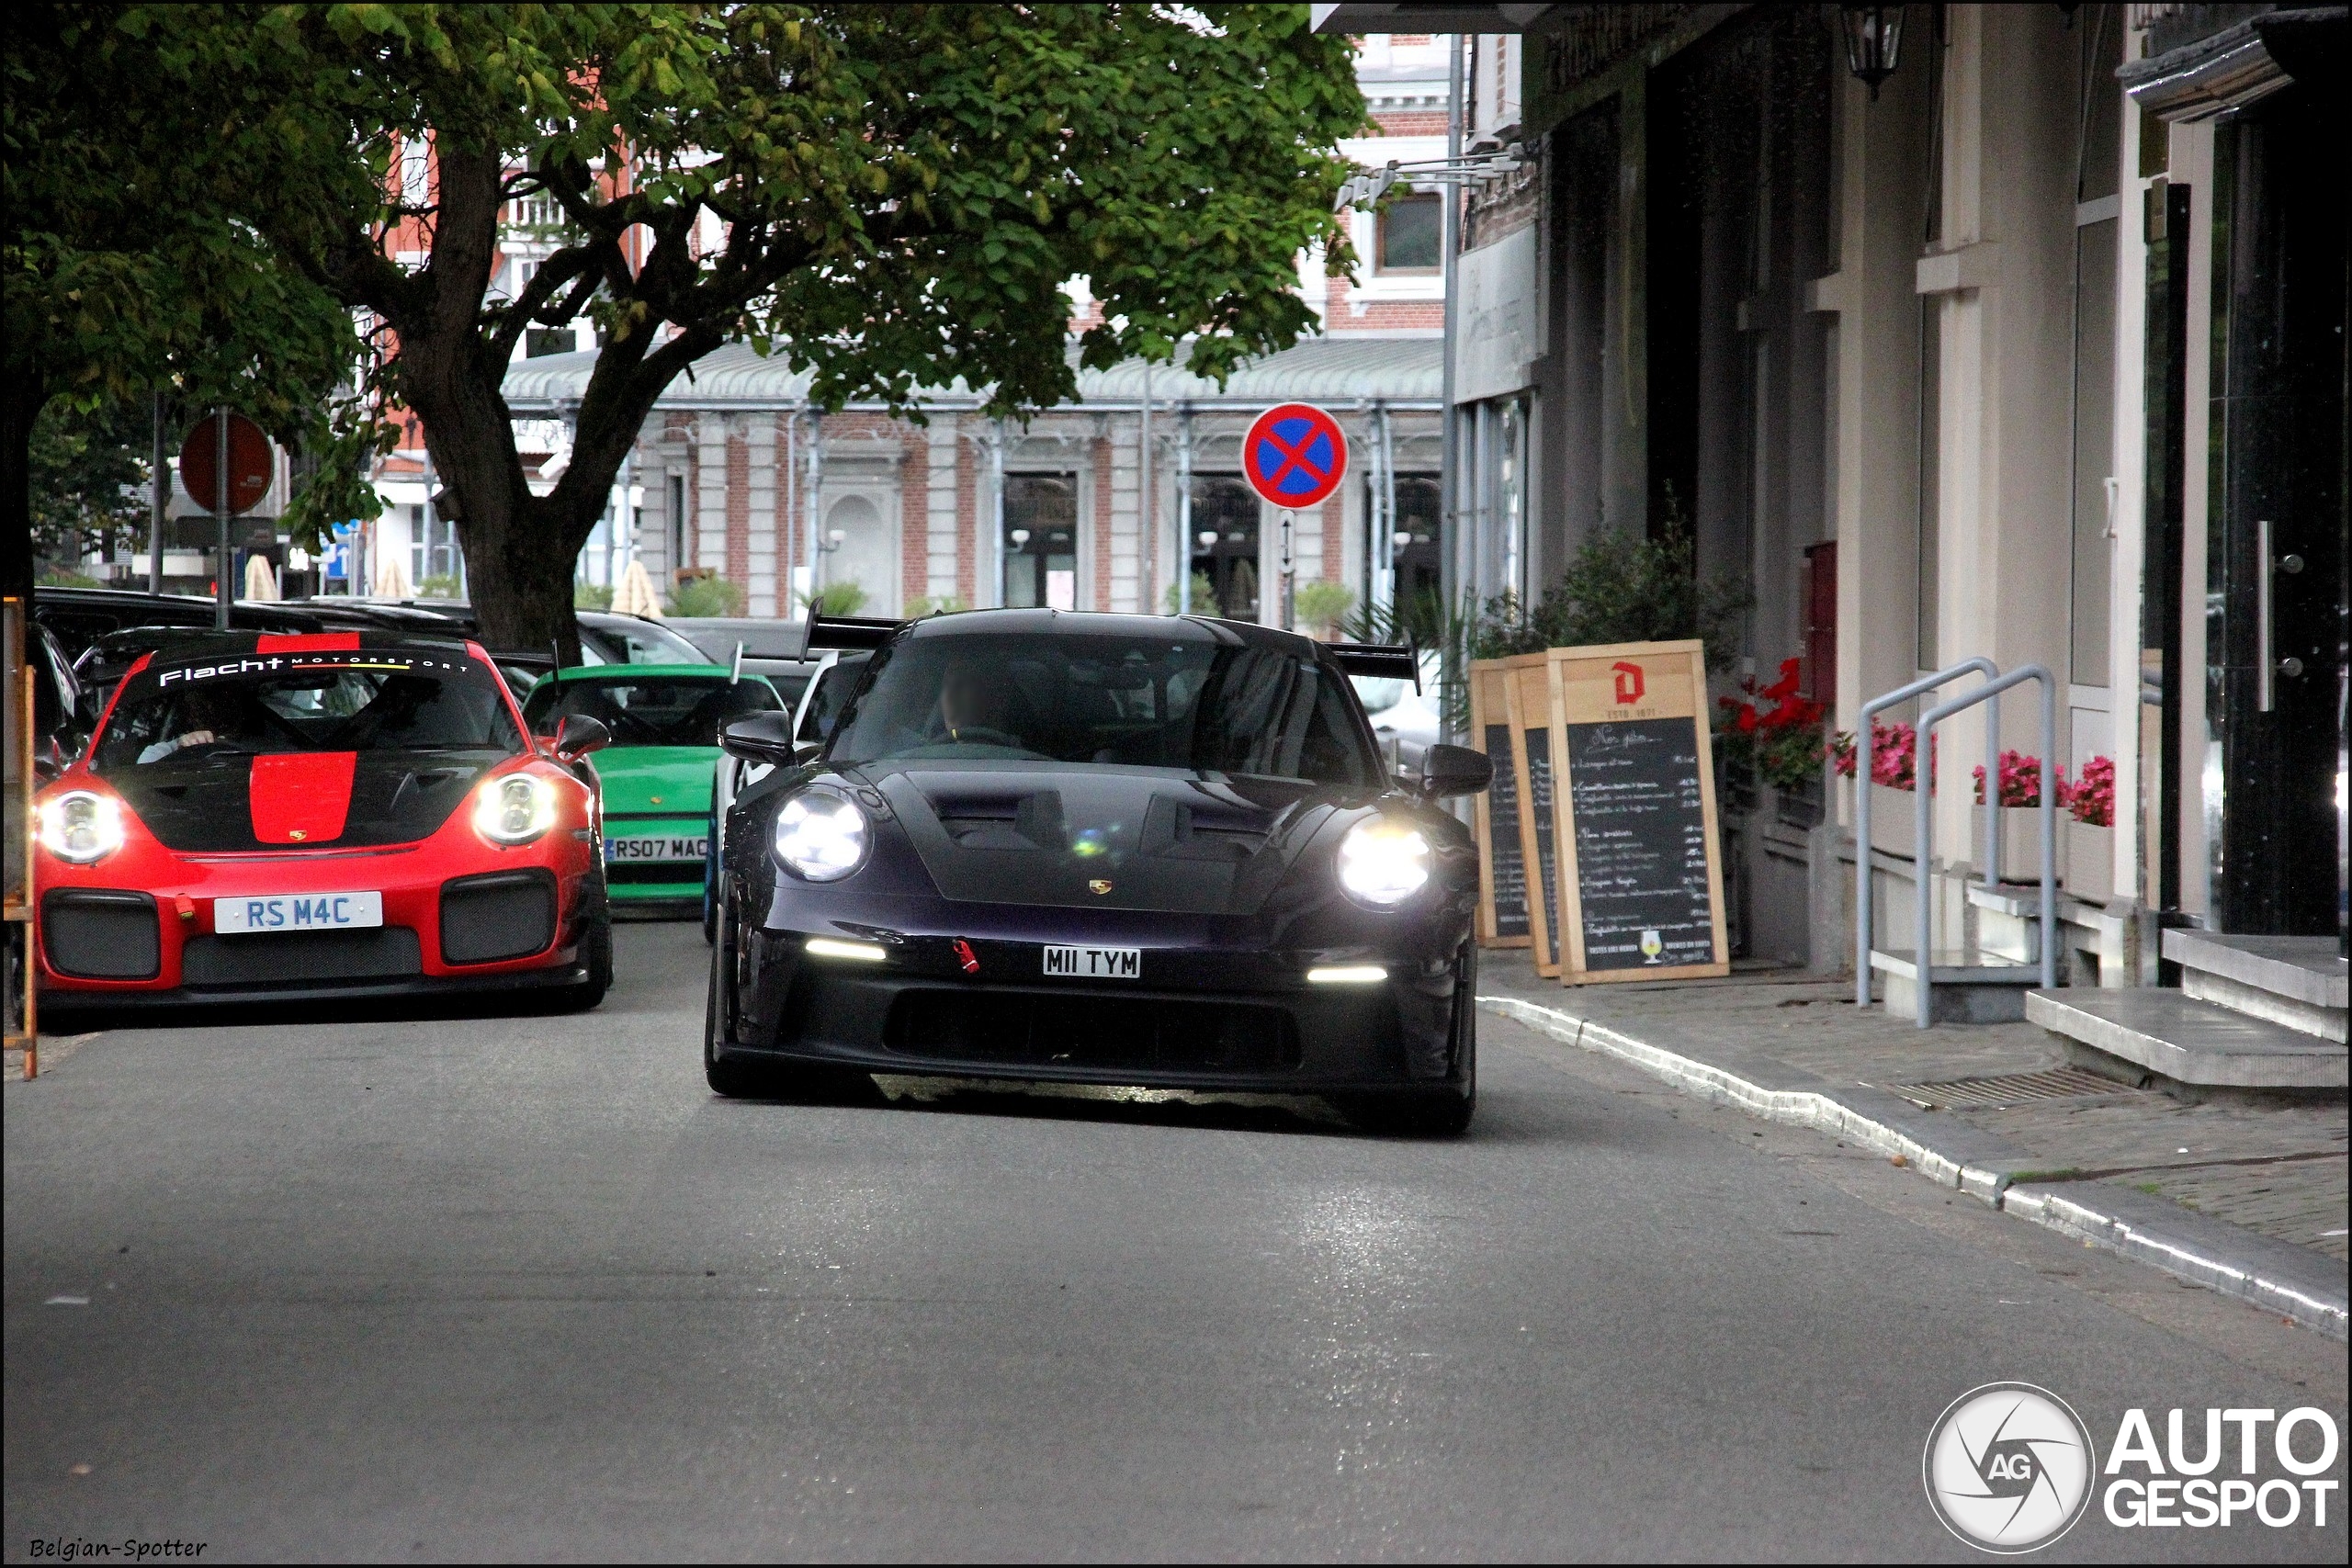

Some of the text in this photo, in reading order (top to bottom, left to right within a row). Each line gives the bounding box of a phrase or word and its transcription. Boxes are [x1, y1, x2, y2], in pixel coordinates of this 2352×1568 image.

[160, 657, 469, 686] Flacht MOTORSPORT
[616, 840, 708, 857] RS07 MAC
[247, 897, 350, 927] RS M4C
[1086, 950, 1137, 975] TYM
